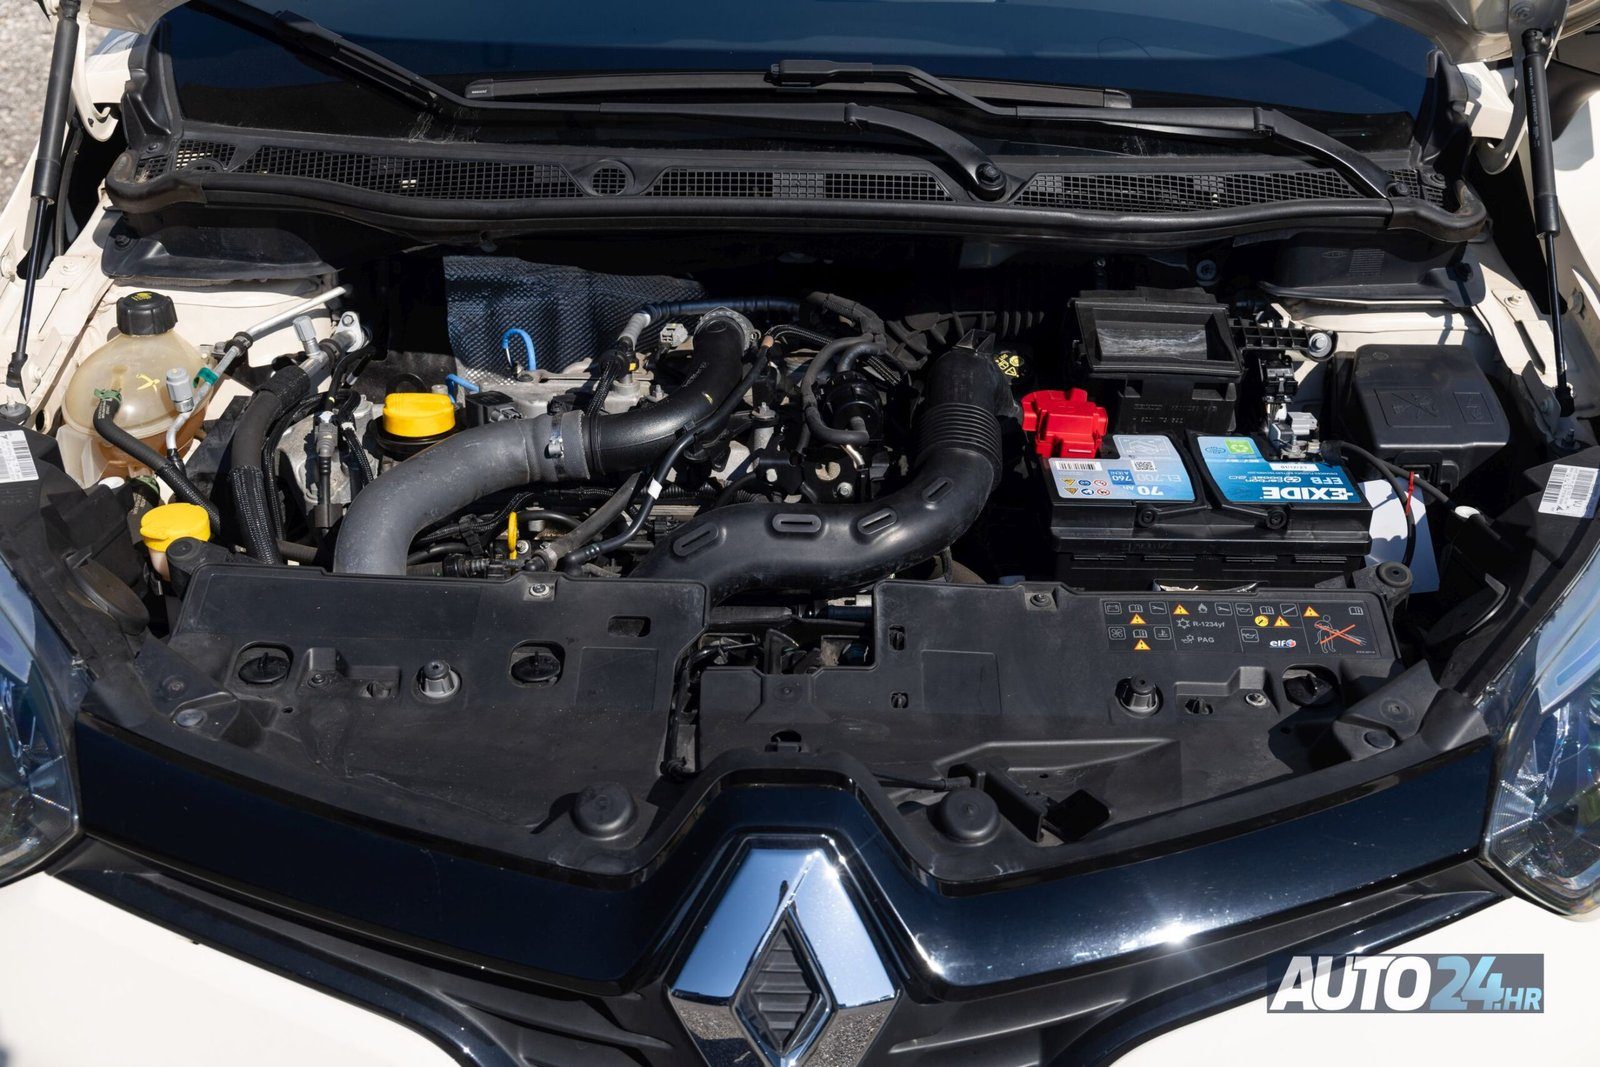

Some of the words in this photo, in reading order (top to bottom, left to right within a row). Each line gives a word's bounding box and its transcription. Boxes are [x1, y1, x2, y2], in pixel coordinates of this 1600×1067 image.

[1136, 474, 1182, 482] EL700
[1311, 476, 1344, 485] EFB
[1136, 486, 1164, 496] 70
[1261, 486, 1353, 501] EXIDE
[1269, 639, 1286, 648] elf
